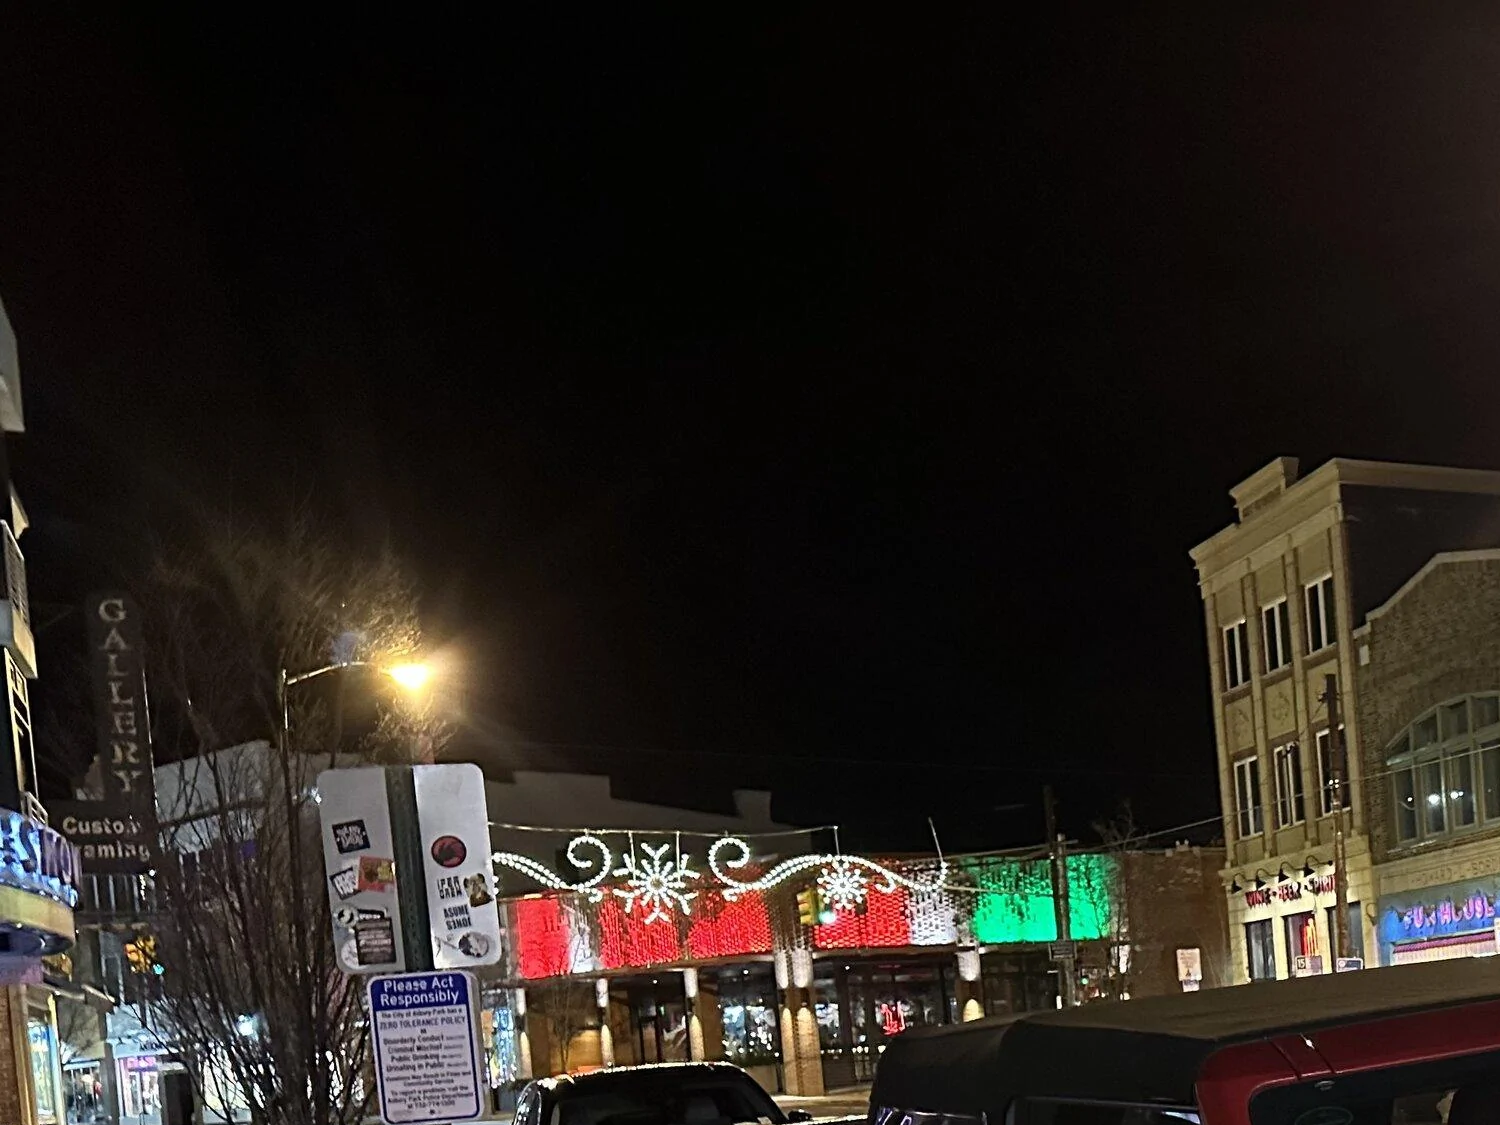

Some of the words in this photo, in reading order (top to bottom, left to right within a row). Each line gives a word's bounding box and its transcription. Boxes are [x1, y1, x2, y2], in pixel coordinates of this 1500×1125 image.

[98, 600, 143, 793] GALLERY
[76, 839, 151, 863] raming
[383, 979, 428, 992] Please
[431, 975, 454, 989] Act
[380, 989, 460, 1007] Responsibly
[380, 1020, 398, 1031] ZERO
[399, 1017, 439, 1029] TOLERANCE
[440, 1015, 466, 1026] POLICY
[417, 1033, 444, 1043] Conduct
